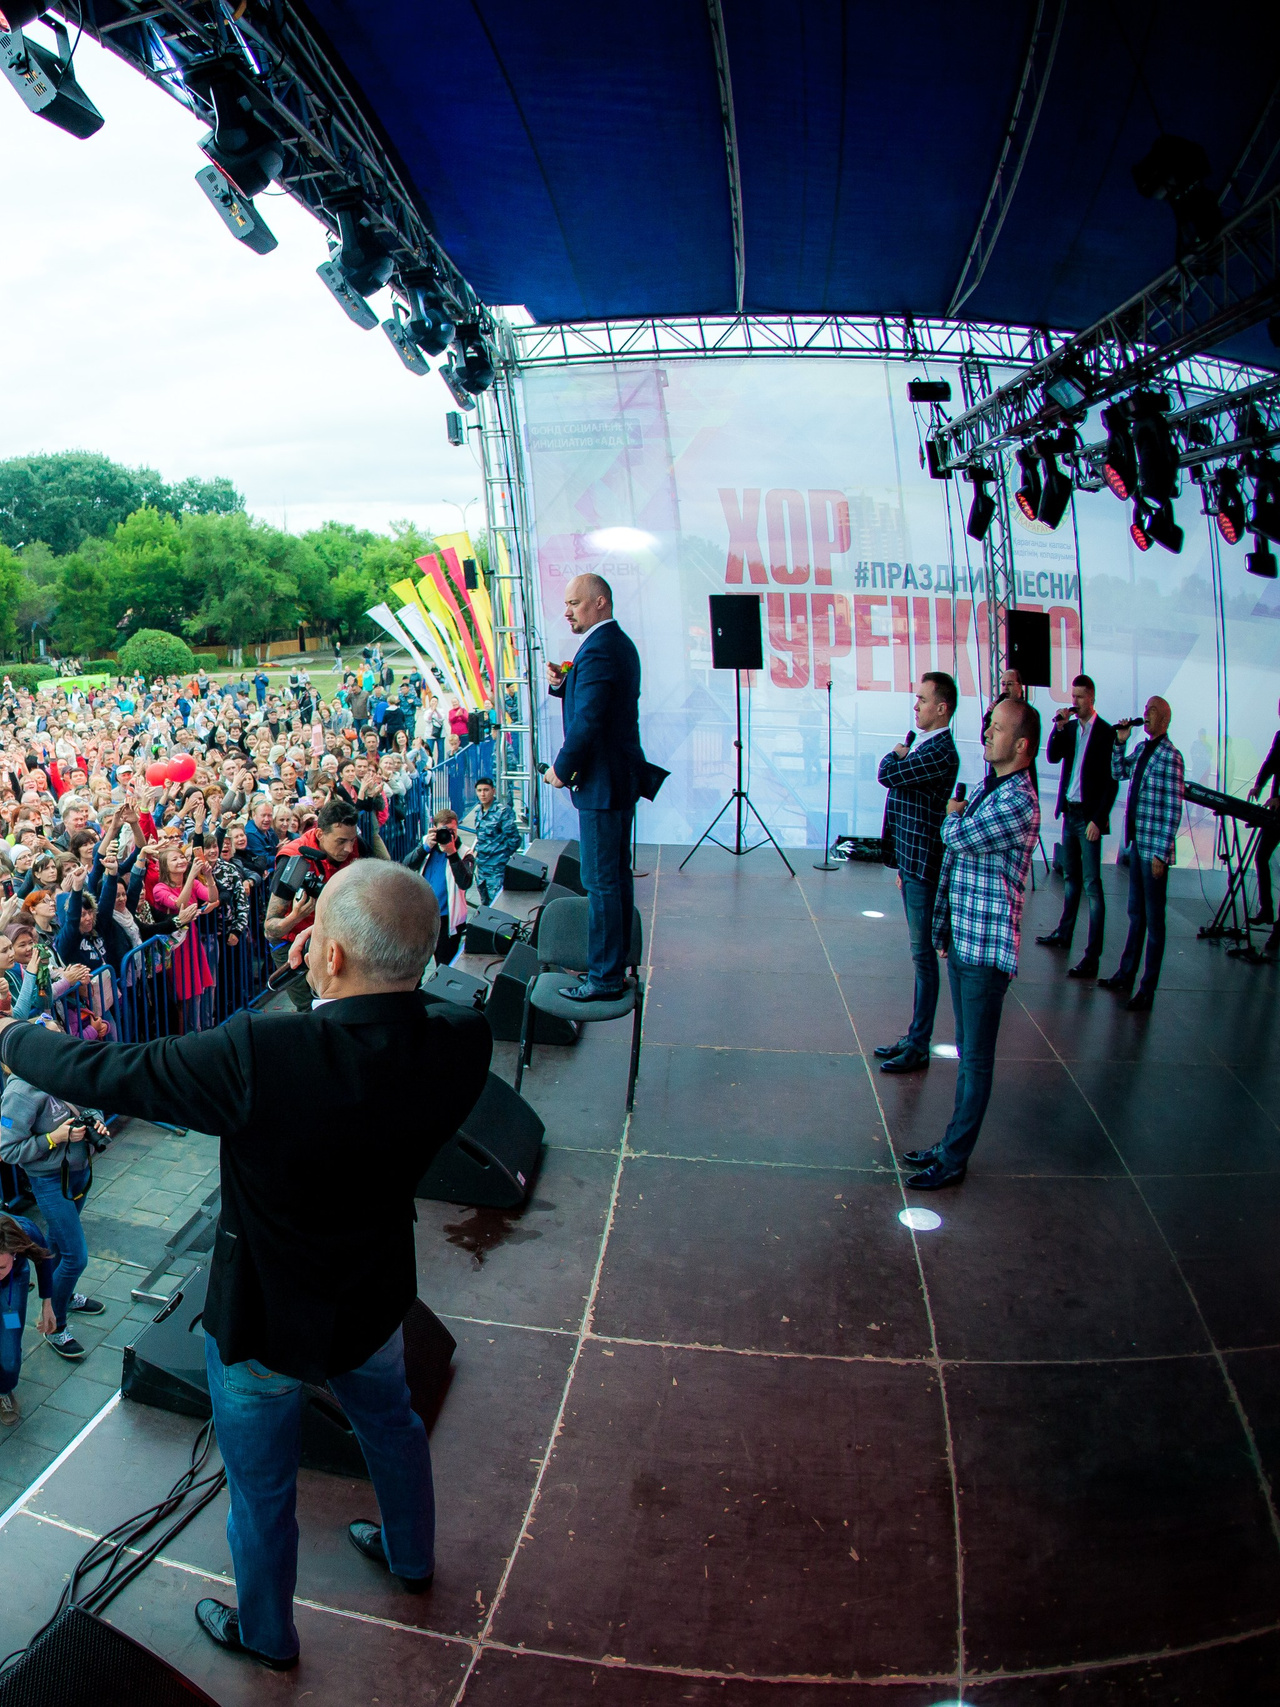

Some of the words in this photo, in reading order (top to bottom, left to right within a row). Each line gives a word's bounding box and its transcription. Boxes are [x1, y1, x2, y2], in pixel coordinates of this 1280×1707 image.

[531, 424, 562, 436] ФОНД
[532, 436, 593, 449] ИНИЦИАТИВ
[718, 488, 852, 586] ХОР
[725, 592, 1080, 703] УРЕЦКОО
